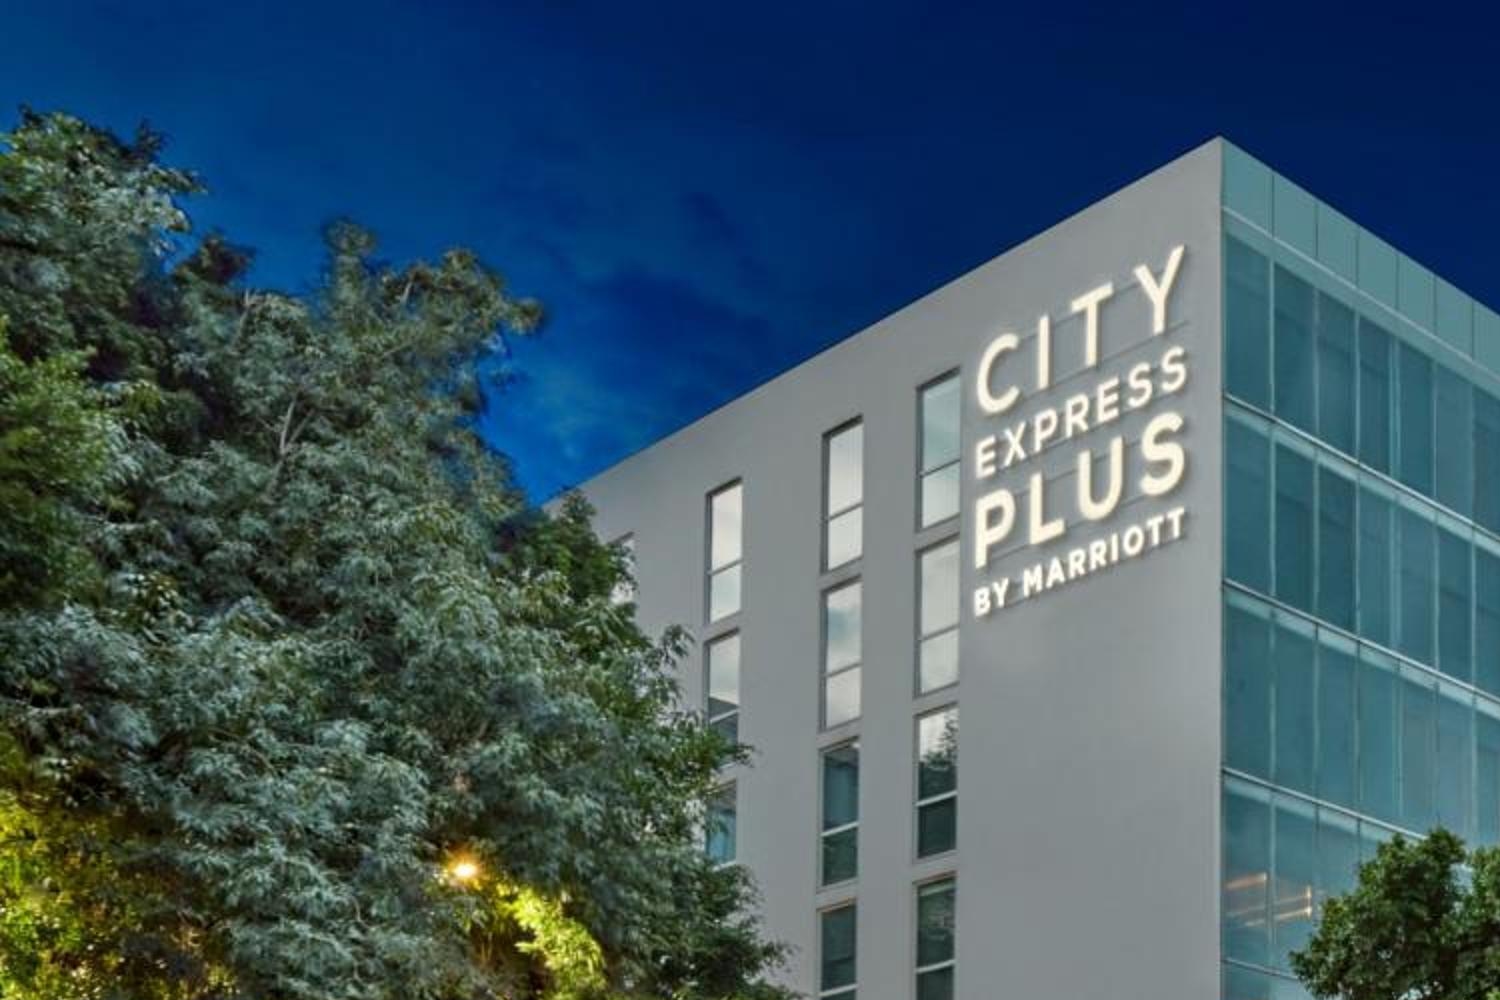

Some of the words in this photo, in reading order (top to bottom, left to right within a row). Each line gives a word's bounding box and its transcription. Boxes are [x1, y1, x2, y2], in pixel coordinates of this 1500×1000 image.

[976, 244, 1185, 413] CITY
[976, 346, 1187, 479] EXPRESS
[974, 577, 1009, 617] BY
[1023, 507, 1186, 598] MARRIOTT
[975, 412, 1186, 569] PLUS
